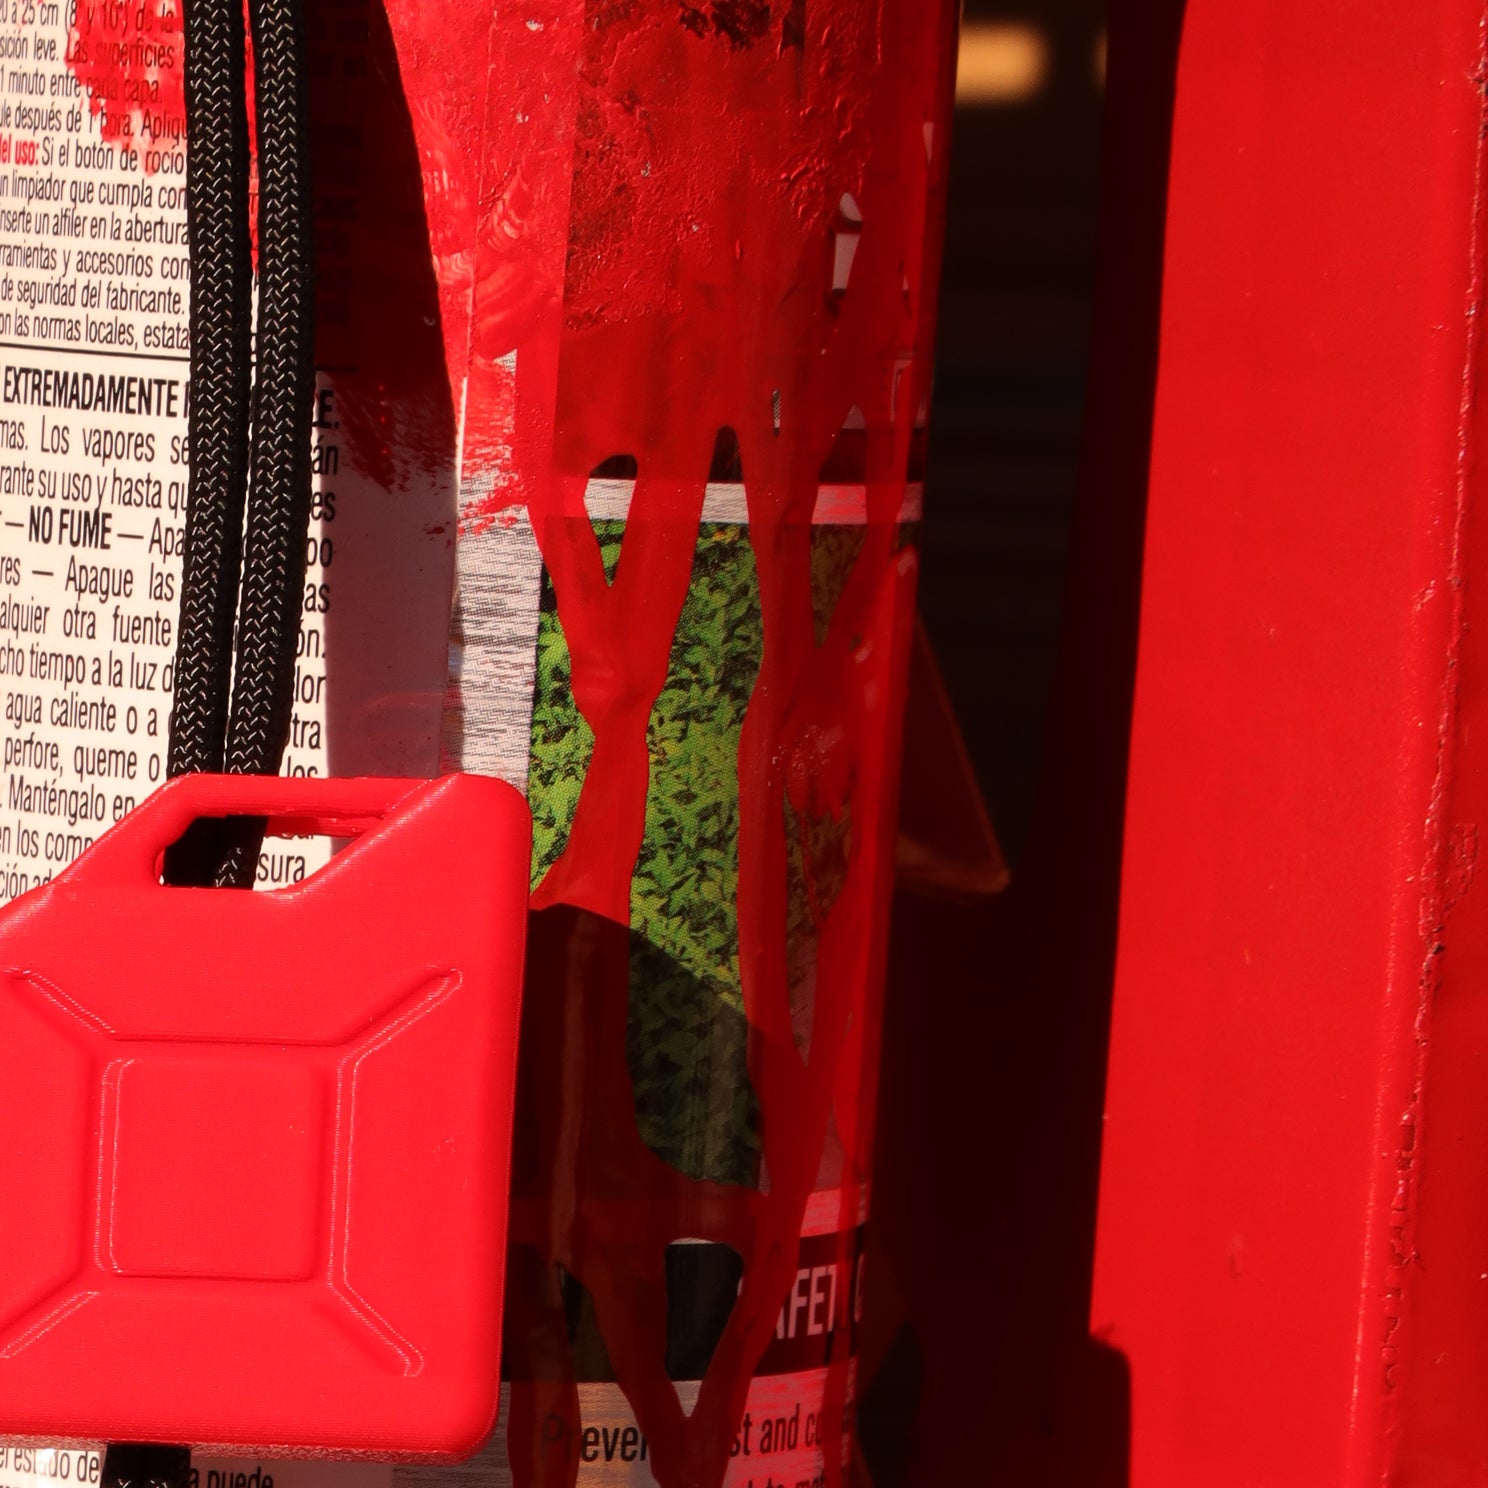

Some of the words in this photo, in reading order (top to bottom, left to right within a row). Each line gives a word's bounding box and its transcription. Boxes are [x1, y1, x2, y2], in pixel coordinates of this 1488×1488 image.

[22, 1, 34, 25] 25
[40, 3, 58, 27] cm
[33, 32, 58, 61] leve.
[9, 67, 45, 95] minuto
[50, 71, 81, 99] entre
[14, 100, 61, 138] después
[66, 105, 82, 133] de
[101, 105, 134, 138] hora.
[14, 140, 39, 167] uso:
[42, 136, 54, 167] Si
[59, 139, 70, 168] el
[75, 140, 113, 171] botón
[120, 145, 137, 174] de
[145, 144, 185, 176] rocío
[12, 170, 66, 206] limpiador
[70, 180, 93, 211] que
[98, 179, 152, 213] cumpla
[158, 187, 187, 211] con
[34, 211, 50, 236] un
[53, 207, 86, 238] alfiler
[90, 217, 106, 240] en
[110, 211, 121, 241] la
[125, 213, 190, 245] abertura
[76, 248, 152, 279] accesorios
[161, 257, 190, 281] con
[17, 276, 76, 310] seguridad
[81, 279, 101, 309] del
[106, 280, 185, 316] fabricante.
[14, 308, 30, 338] las
[34, 314, 81, 343] normas
[86, 313, 138, 351] locales,
[144, 322, 190, 350] estata
[3, 365, 179, 418] EXTREMADAMENTE
[41, 415, 70, 455] Los
[83, 427, 155, 467] vapores
[38, 468, 56, 499] su
[62, 472, 91, 502] uso
[111, 467, 162, 508] hasta
[29, 505, 53, 544] NO
[58, 508, 112, 550] FUME
[64, 554, 133, 604] Apague
[149, 562, 174, 602] las
[63, 602, 96, 641] otra
[111, 605, 172, 648] fuente
[29, 642, 86, 690] tiempo
[108, 650, 123, 689] la
[131, 652, 157, 691] luz
[6, 690, 42, 730] agua
[50, 691, 116, 733] caliente
[4, 732, 63, 777] perfore,
[74, 744, 137, 783] queme
[9, 774, 105, 827] Manténgalo
[17, 820, 39, 858] los
[760, 1402, 802, 1453] and
